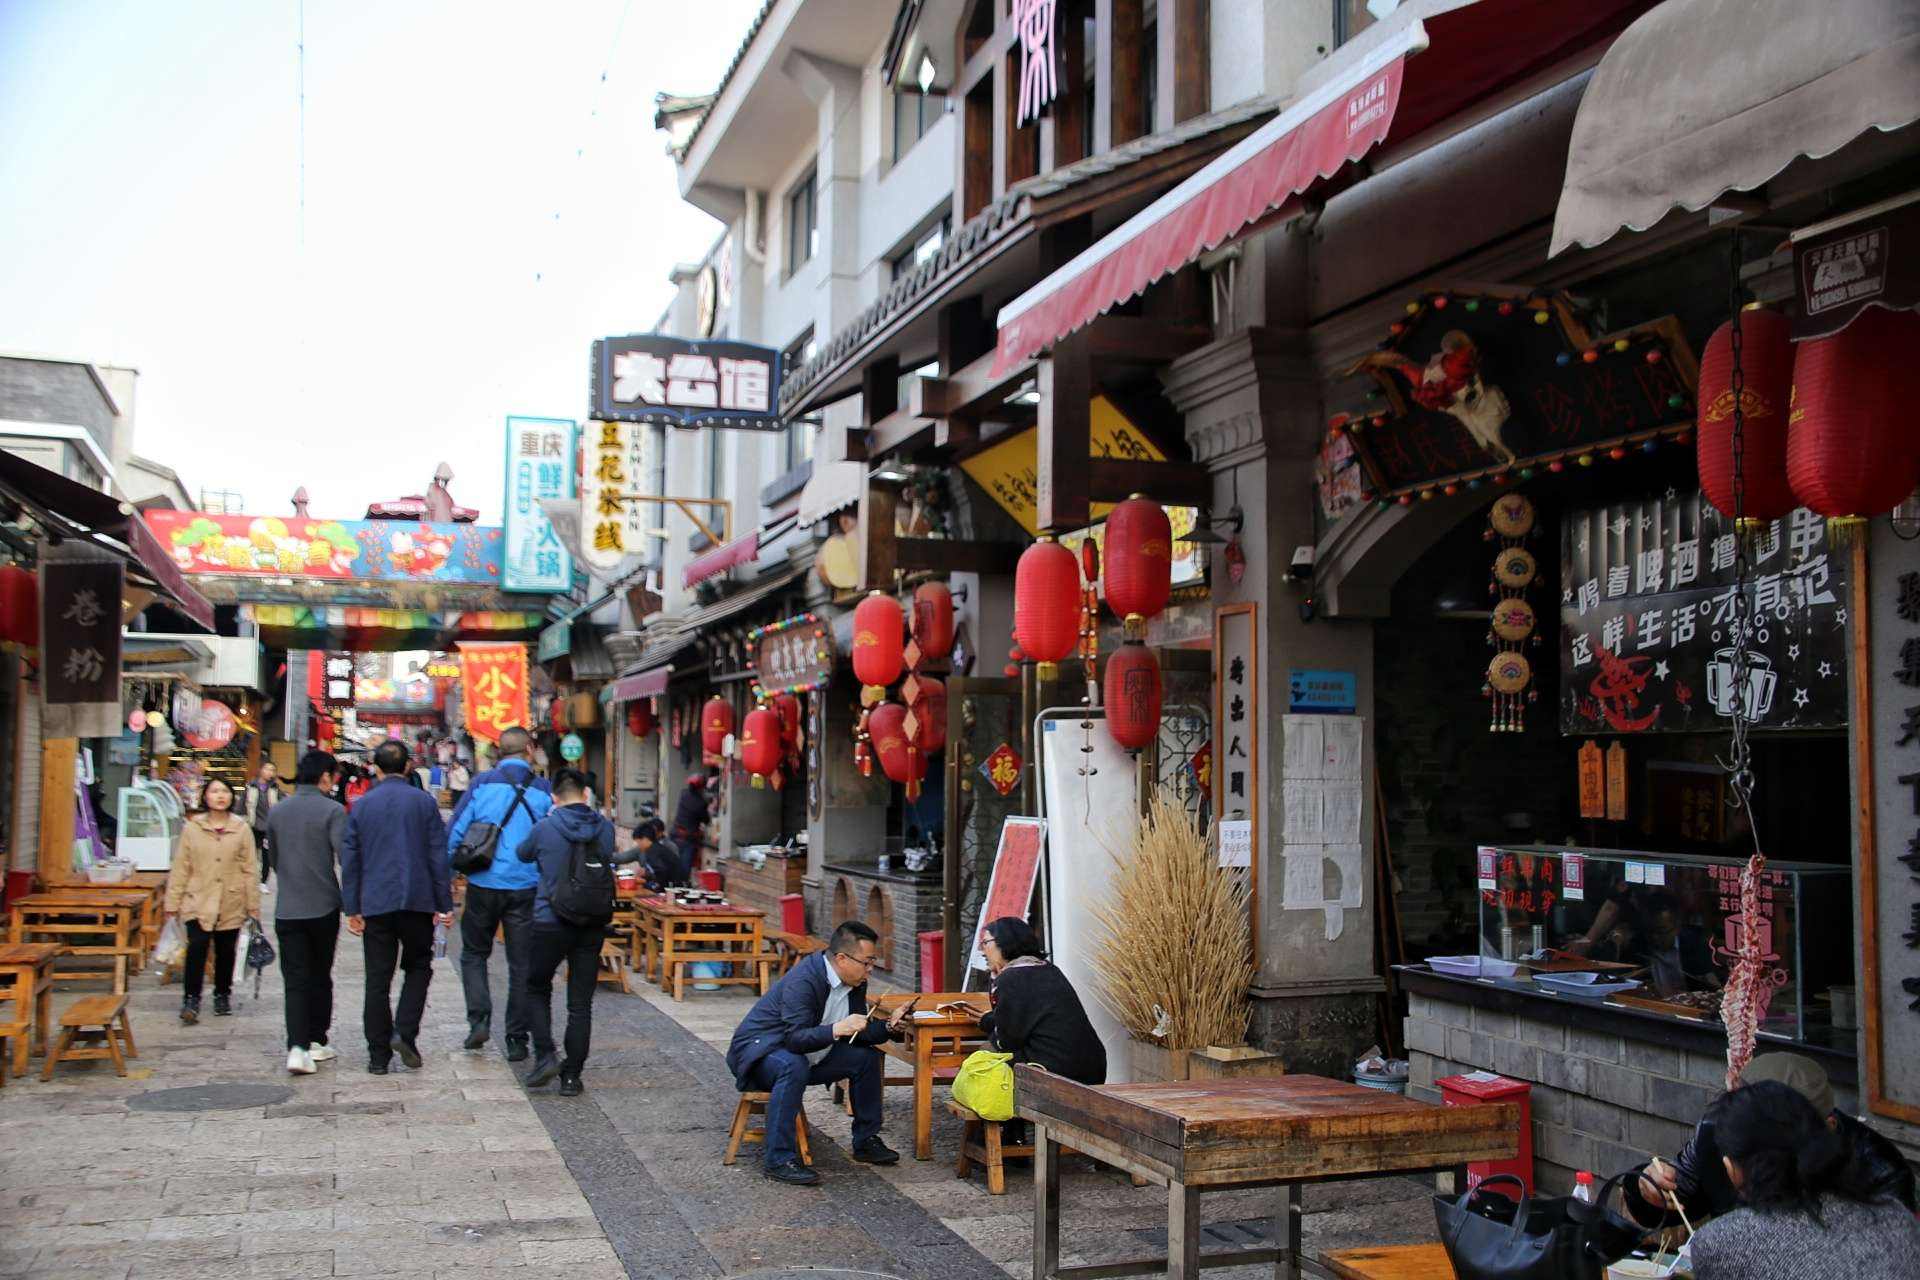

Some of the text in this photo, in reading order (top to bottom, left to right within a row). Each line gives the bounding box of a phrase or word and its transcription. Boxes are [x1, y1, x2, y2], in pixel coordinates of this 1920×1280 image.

[520, 431, 562, 457] 重庆
[473, 665, 521, 732] 小吃
[991, 754, 1019, 783] 福
